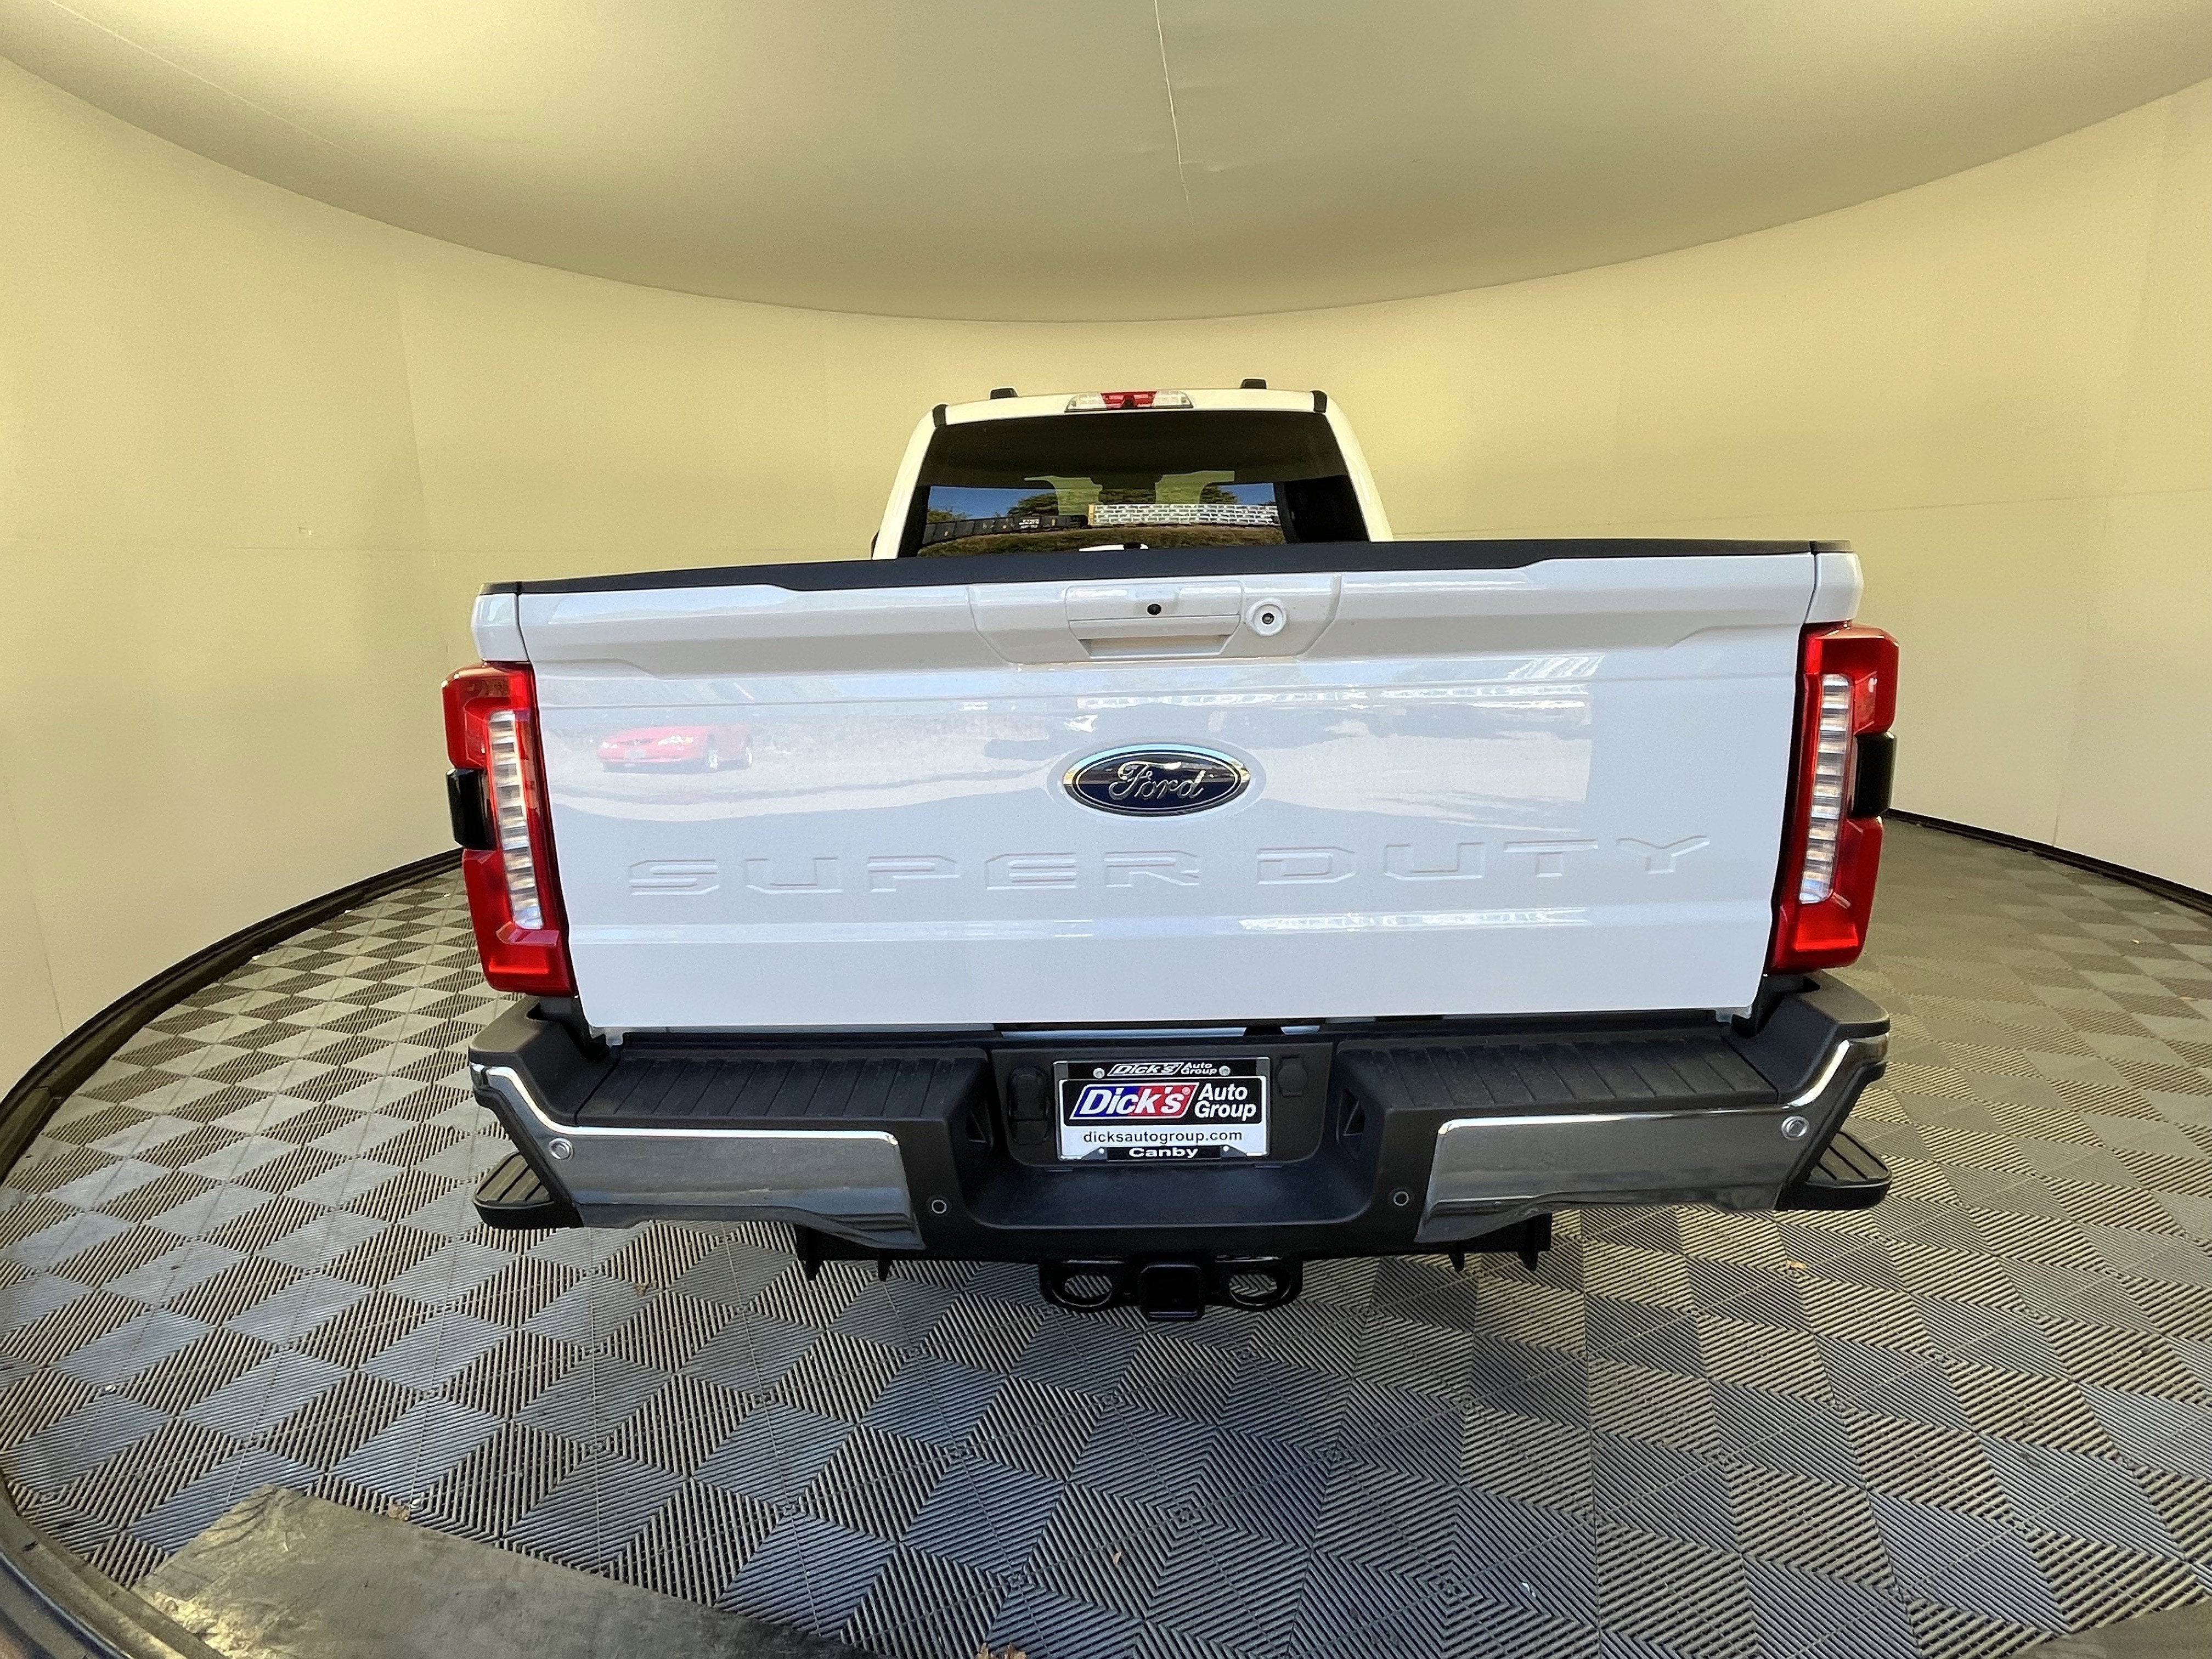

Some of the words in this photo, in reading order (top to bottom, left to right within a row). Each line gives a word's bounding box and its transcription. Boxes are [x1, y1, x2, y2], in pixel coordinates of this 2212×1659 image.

[1108, 760, 1207, 800] Ford
[628, 849, 1200, 896] SUPER
[1256, 834, 1711, 884] DUTY
[1079, 1086, 1186, 1115] Dick's
[1198, 1083, 1249, 1101] Auto
[1194, 1101, 1257, 1121] Group
[1083, 1130, 1243, 1144] dicksautogroup.com
[1128, 1147, 1199, 1159] Canby
